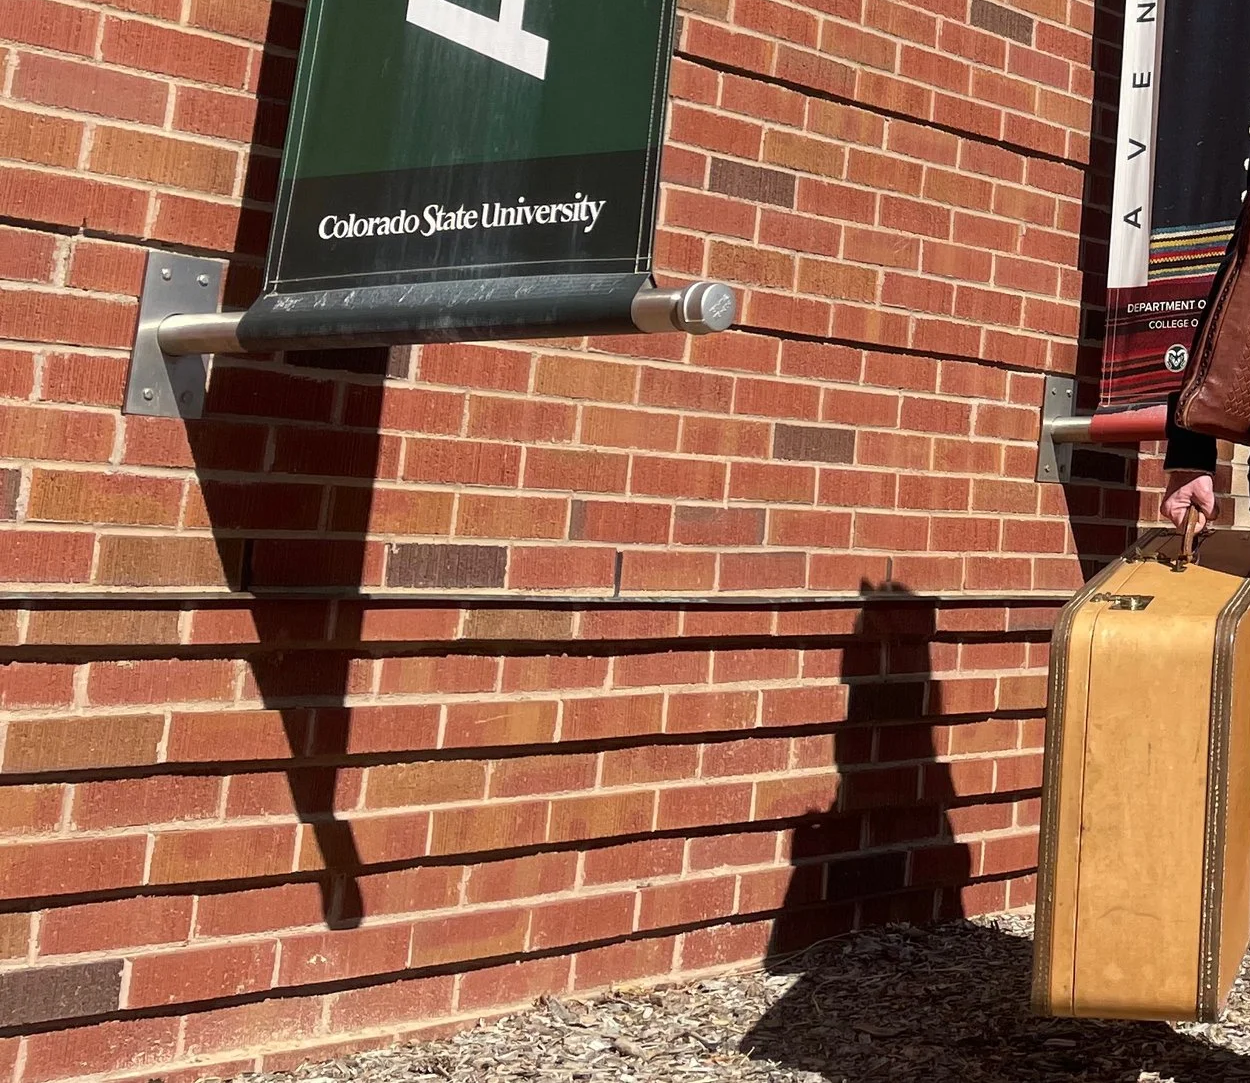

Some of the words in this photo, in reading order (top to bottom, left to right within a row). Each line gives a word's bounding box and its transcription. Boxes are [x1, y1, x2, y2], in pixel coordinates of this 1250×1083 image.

[318, 209, 419, 240] Colorado
[420, 204, 478, 237] State
[481, 192, 607, 233] University
[1127, 299, 1196, 313] DEPARTMENT
[1197, 299, 1207, 309] O
[1148, 319, 1189, 330] COLLEGE
[1190, 318, 1199, 327] O
